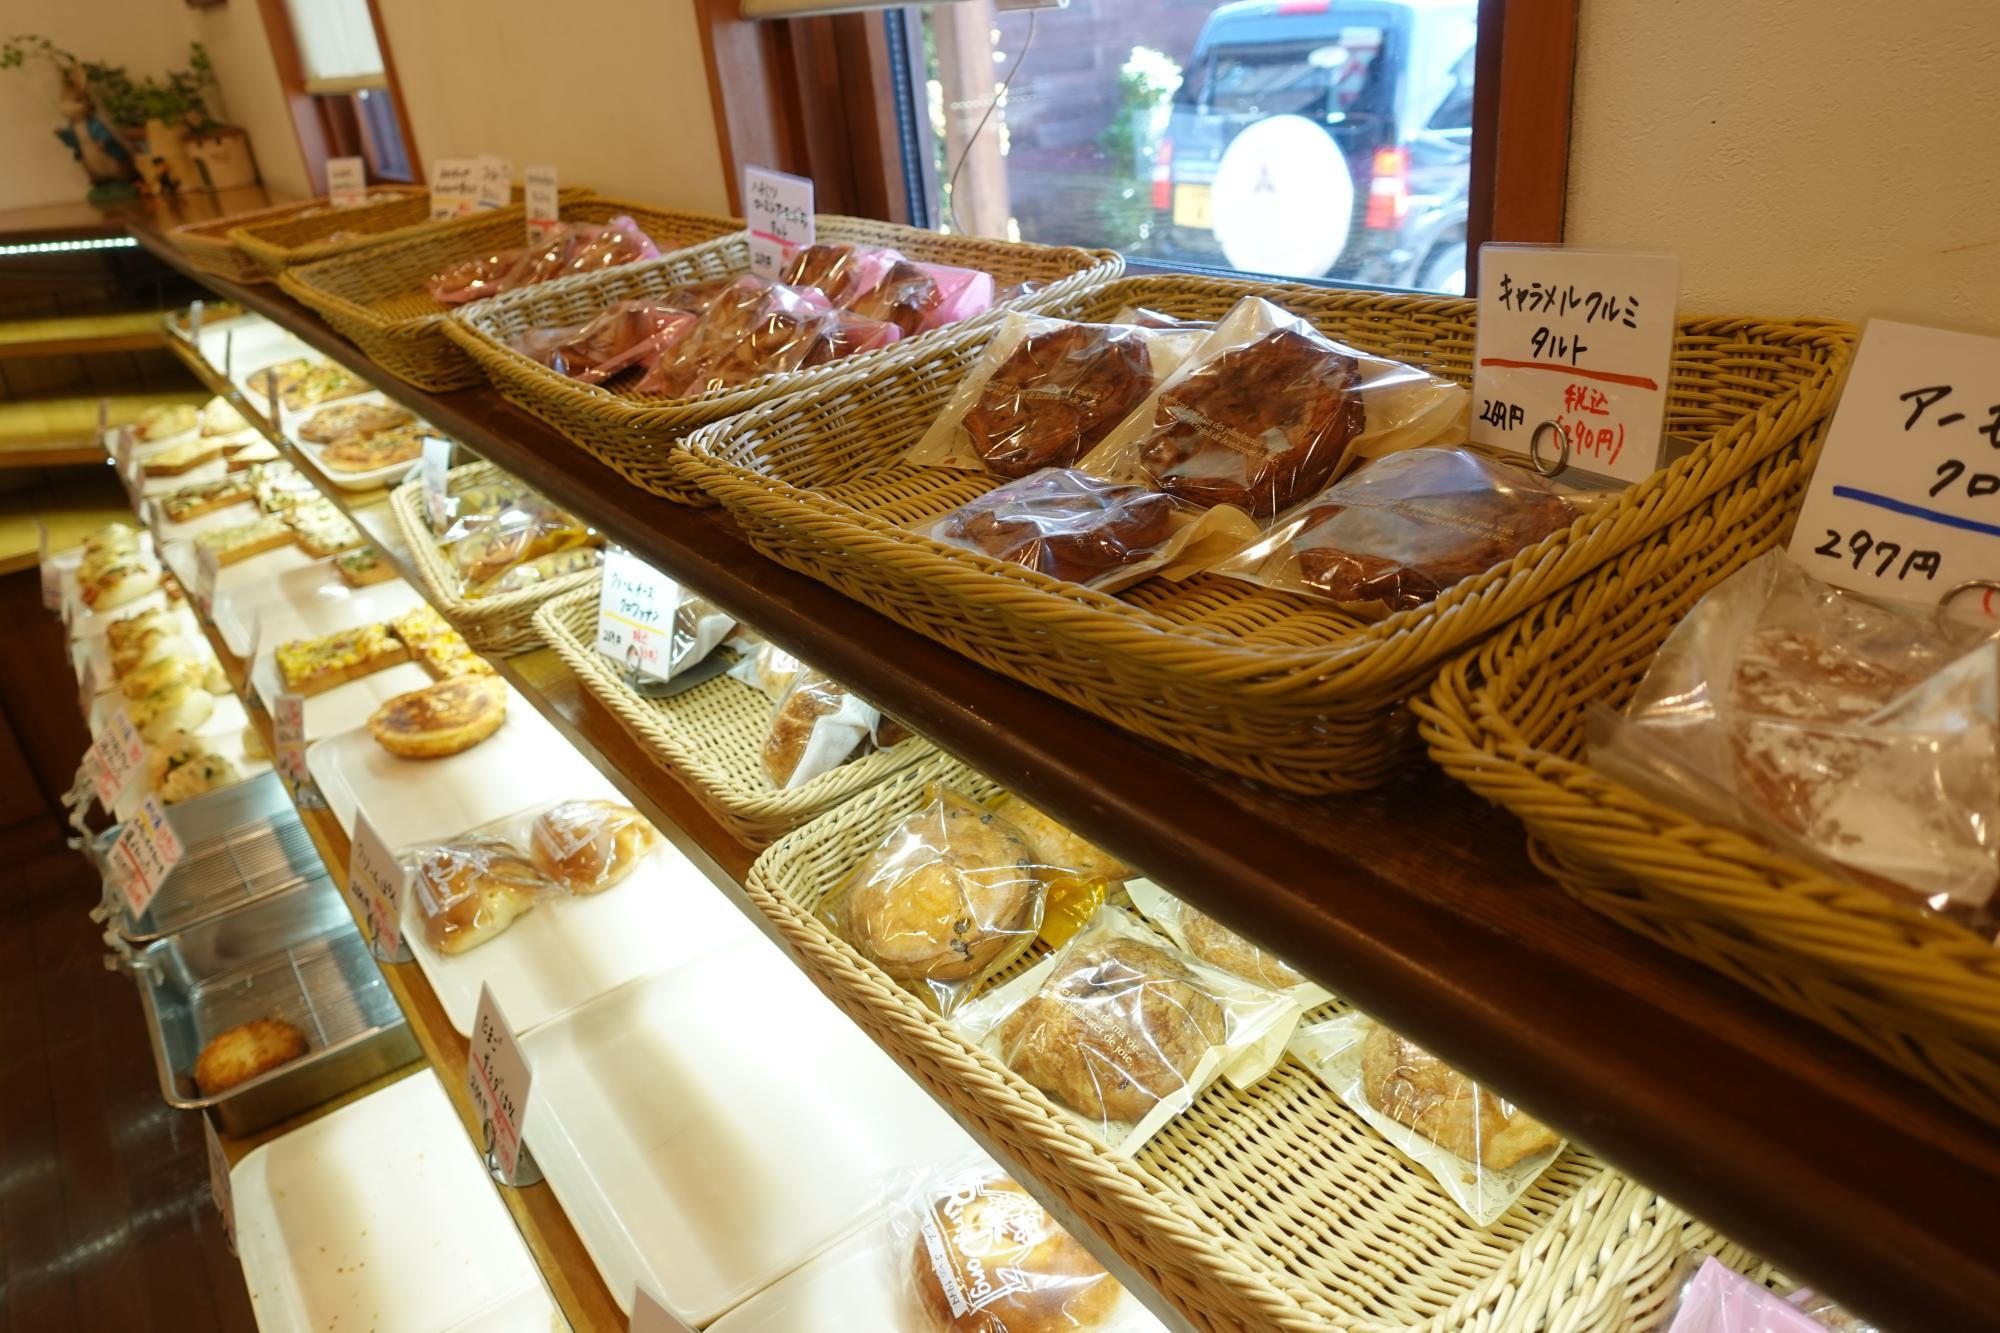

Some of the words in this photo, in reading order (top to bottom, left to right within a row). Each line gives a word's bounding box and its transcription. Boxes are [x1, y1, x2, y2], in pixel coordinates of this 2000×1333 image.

[1499, 273, 1639, 329] キャラメルクルミ
[1531, 326, 1588, 366] タルト
[1564, 384, 1610, 416] 税込
[1814, 529, 1942, 581] 297円
